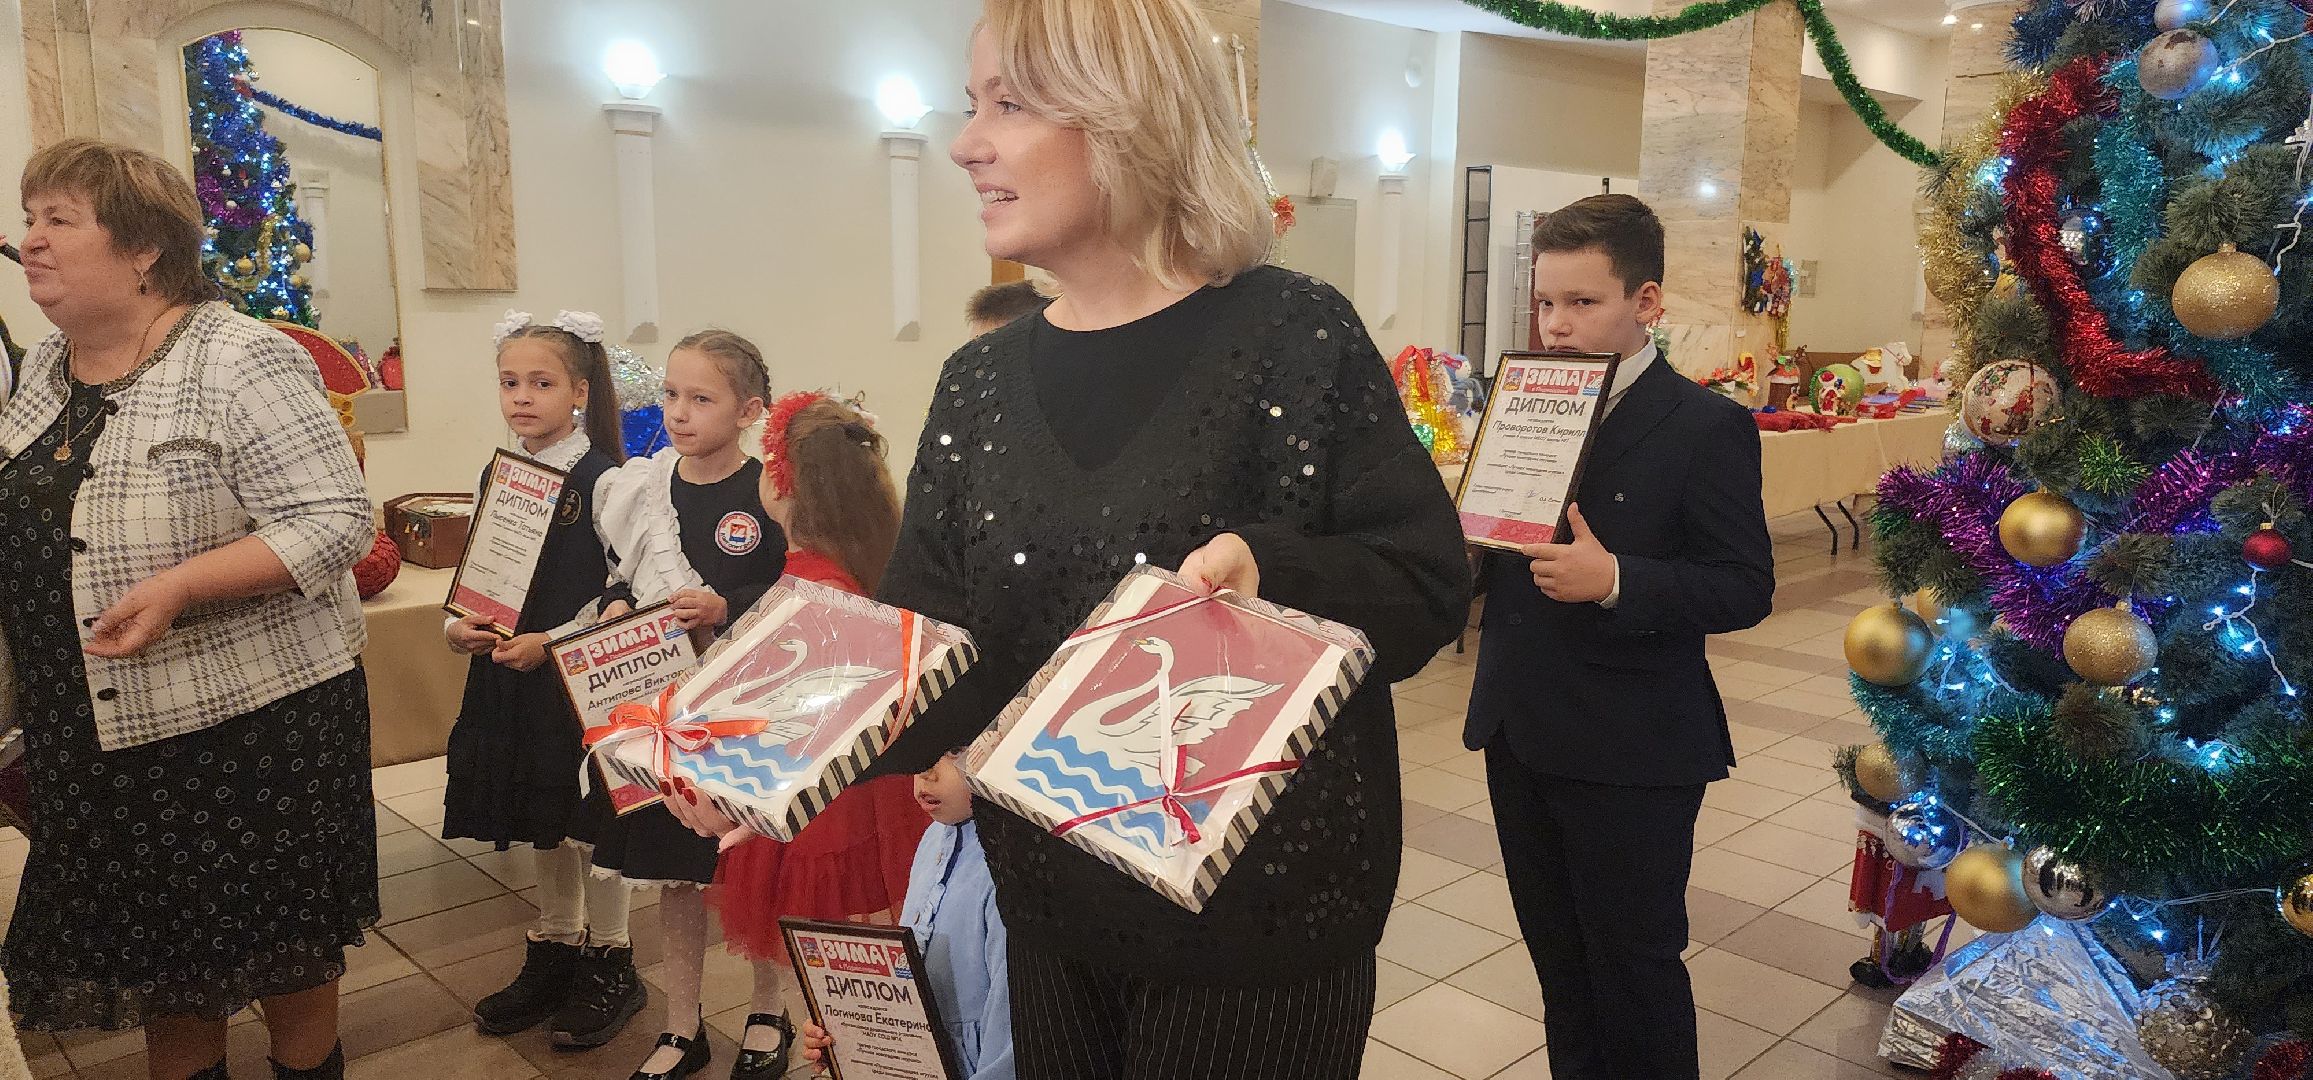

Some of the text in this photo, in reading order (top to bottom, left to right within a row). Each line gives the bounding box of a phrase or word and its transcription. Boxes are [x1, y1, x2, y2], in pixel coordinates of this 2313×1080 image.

[1527, 368, 1580, 387] ЗИМА
[1505, 396, 1587, 416] ДИПЛОМ
[1493, 420, 1548, 434] Проворотов
[1549, 425, 1587, 438] Кирилл
[512, 467, 548, 493] ЗИМА
[496, 490, 549, 520] ДИПЛОМ
[589, 624, 656, 658] ЗИМА
[588, 644, 681, 693] ДИПЛОМ
[588, 685, 642, 711] Антипова
[645, 668, 685, 690] Виктор
[823, 940, 886, 966] ЗИМА
[825, 974, 913, 1005] ДИПЛОМ
[825, 1004, 873, 1023] Логинова
